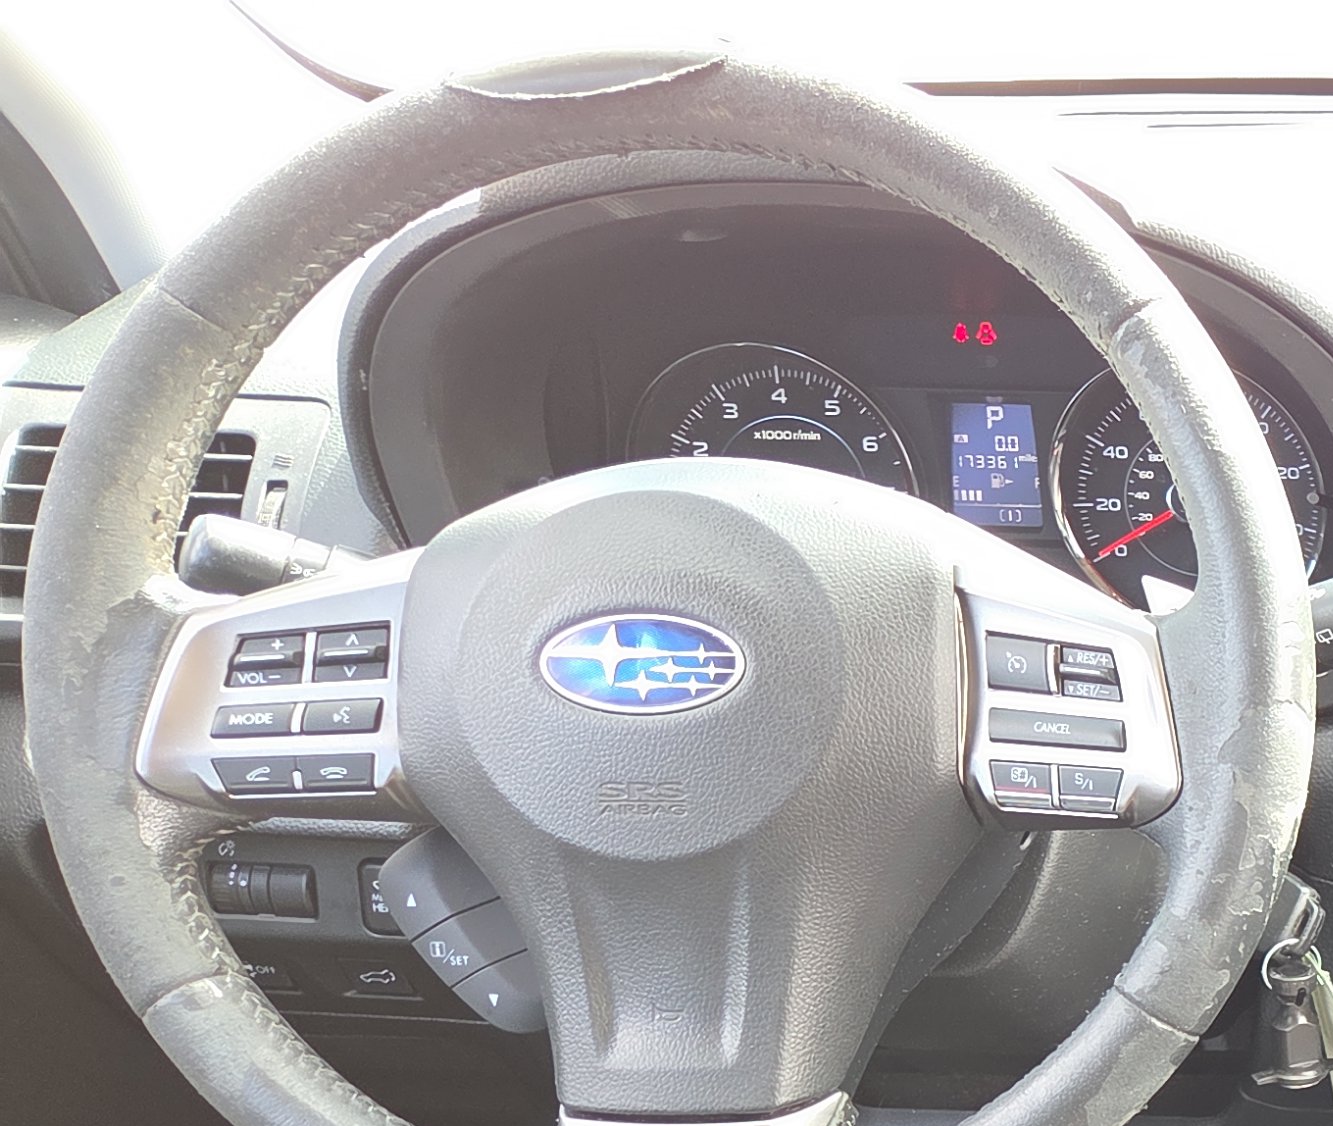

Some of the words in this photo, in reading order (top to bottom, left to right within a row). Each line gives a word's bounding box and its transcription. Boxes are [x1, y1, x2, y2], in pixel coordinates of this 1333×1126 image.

[771, 388, 788, 404] 4
[722, 403, 739, 419] 3
[824, 400, 841, 416] 5
[986, 406, 1004, 429] P
[692, 442, 709, 457] 2
[862, 437, 879, 452] 6
[995, 435, 1019, 452] 0.0
[1102, 445, 1129, 459] 40
[1148, 453, 1164, 463] 80
[958, 455, 1019, 469] 173361
[1139, 470, 1154, 480] 60
[1277, 466, 1300, 480] 20
[953, 476, 960, 488] E
[1134, 491, 1150, 500] 40
[1096, 498, 1121, 511] 20
[1136, 512, 1153, 522] 20
[1114, 546, 1128, 557] 0
[237, 672, 267, 685] VOL
[228, 712, 274, 726] MODE
[1034, 721, 1071, 735] CANCEL
[599, 780, 685, 800] SRS
[600, 803, 688, 816] AIRBAG
